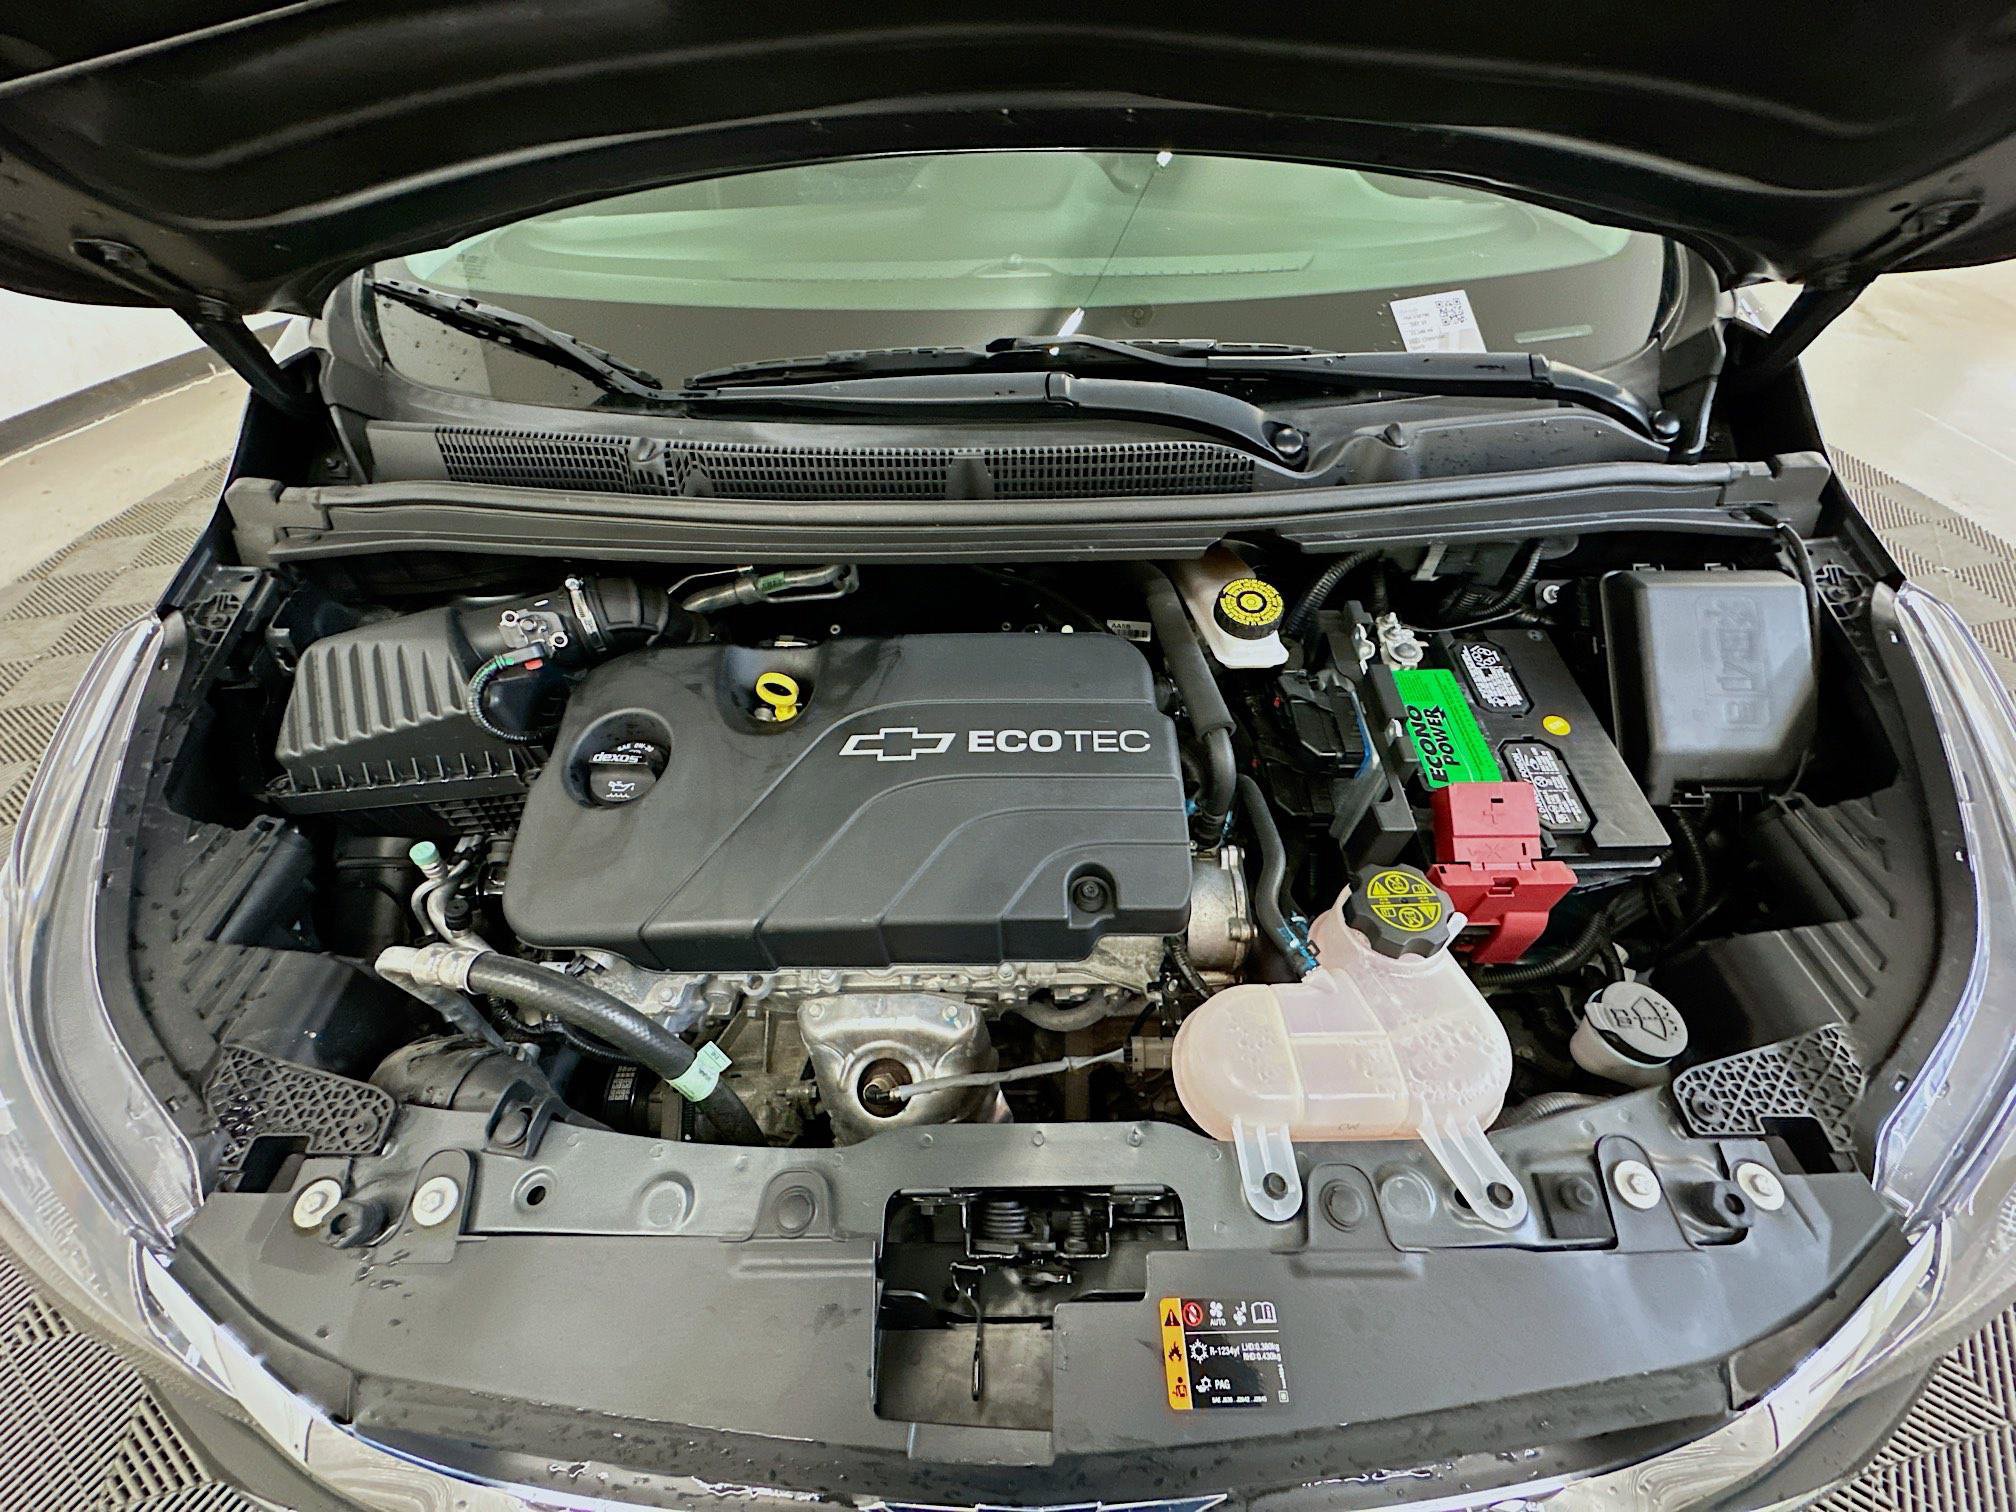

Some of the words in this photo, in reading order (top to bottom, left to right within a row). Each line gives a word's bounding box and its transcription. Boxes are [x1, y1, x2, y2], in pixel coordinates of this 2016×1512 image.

[968, 729, 1152, 754] ECOTEC
[1405, 704, 1448, 783] ECONO
[1424, 704, 1461, 766] POWER
[592, 752, 640, 764] dexos
[1210, 1318, 1227, 1327] AUTO
[1214, 1379, 1231, 1390] PAG
